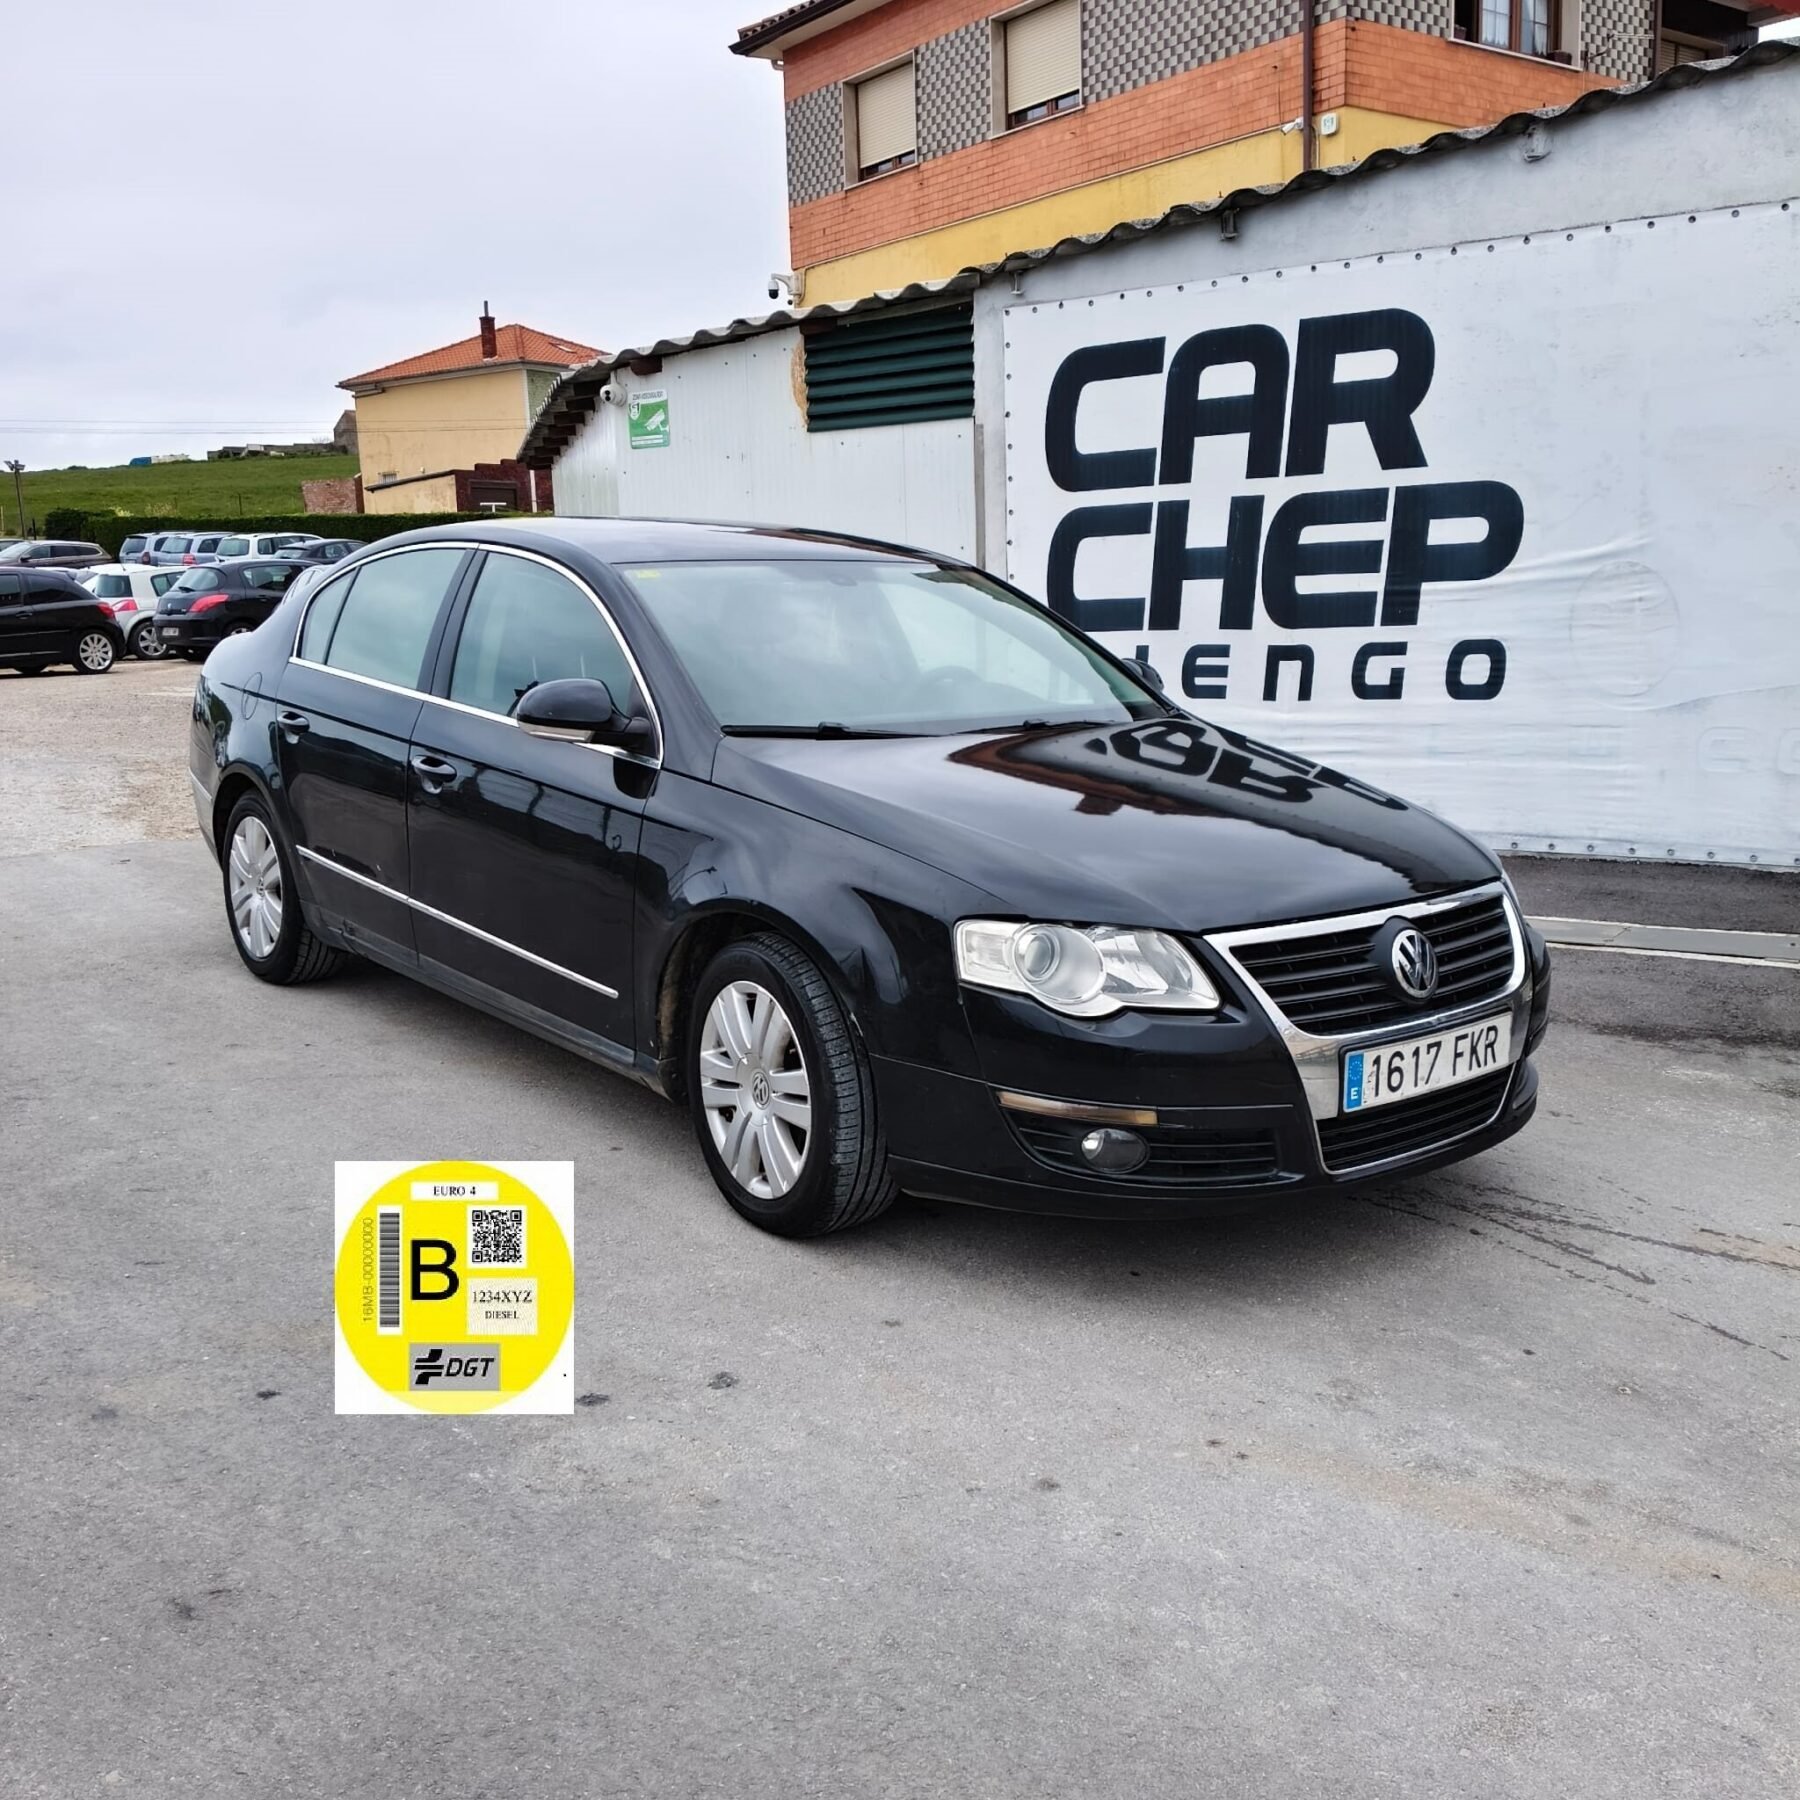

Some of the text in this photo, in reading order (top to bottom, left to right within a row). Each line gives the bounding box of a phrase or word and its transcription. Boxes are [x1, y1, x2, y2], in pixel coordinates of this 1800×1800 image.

[1045, 308, 1435, 492] CAR
[1047, 480, 1524, 632] CHEP
[1351, 1087, 1359, 1100] E
[1372, 1025, 1499, 1097] 1617 FKR
